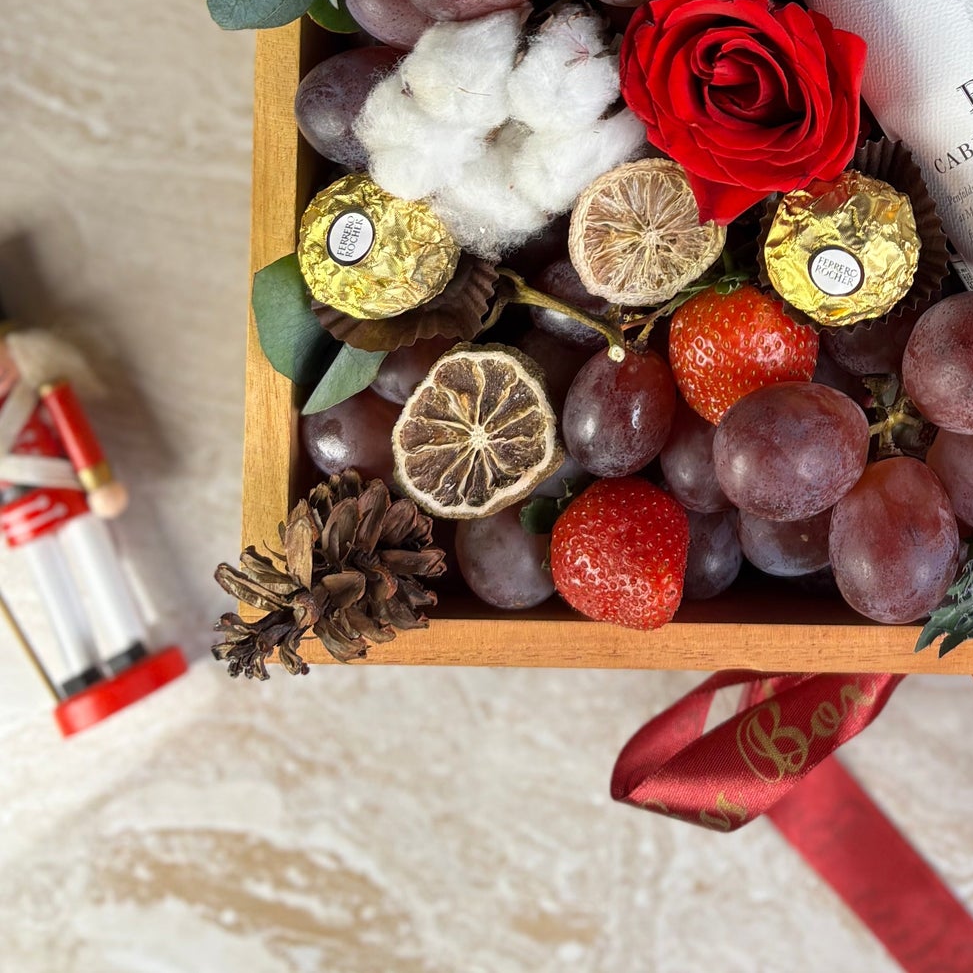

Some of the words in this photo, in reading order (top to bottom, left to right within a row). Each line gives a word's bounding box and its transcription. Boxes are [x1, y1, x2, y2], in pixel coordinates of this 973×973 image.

[337, 216, 355, 256] FERRERO
[345, 218, 363, 257] ROCHER
[815, 264, 853, 287] ROCHER
